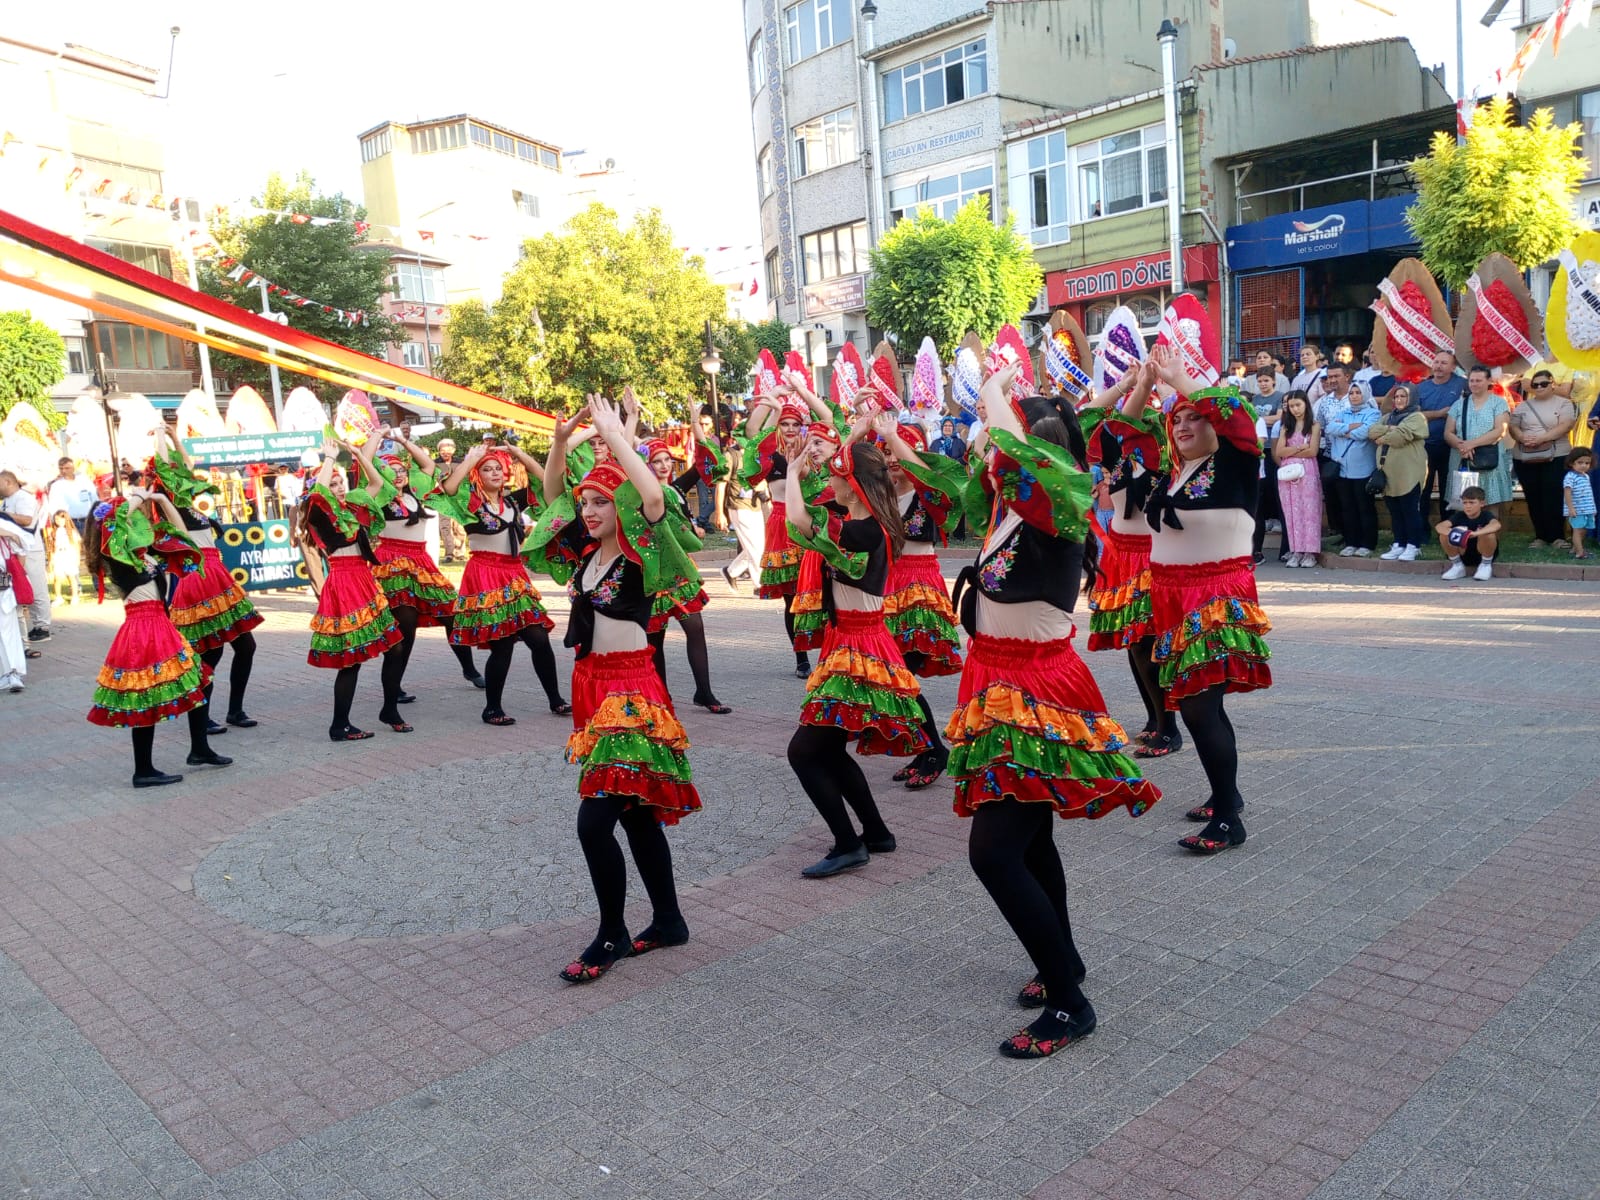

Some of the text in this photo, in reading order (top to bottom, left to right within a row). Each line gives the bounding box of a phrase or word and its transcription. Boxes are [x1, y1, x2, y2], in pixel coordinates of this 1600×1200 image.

[929, 127, 981, 148] RESTAURANT
[1284, 225, 1340, 246] Marshall
[1314, 242, 1338, 252] colour
[1066, 271, 1117, 298] TADIM
[1121, 260, 1187, 288] DÖNE
